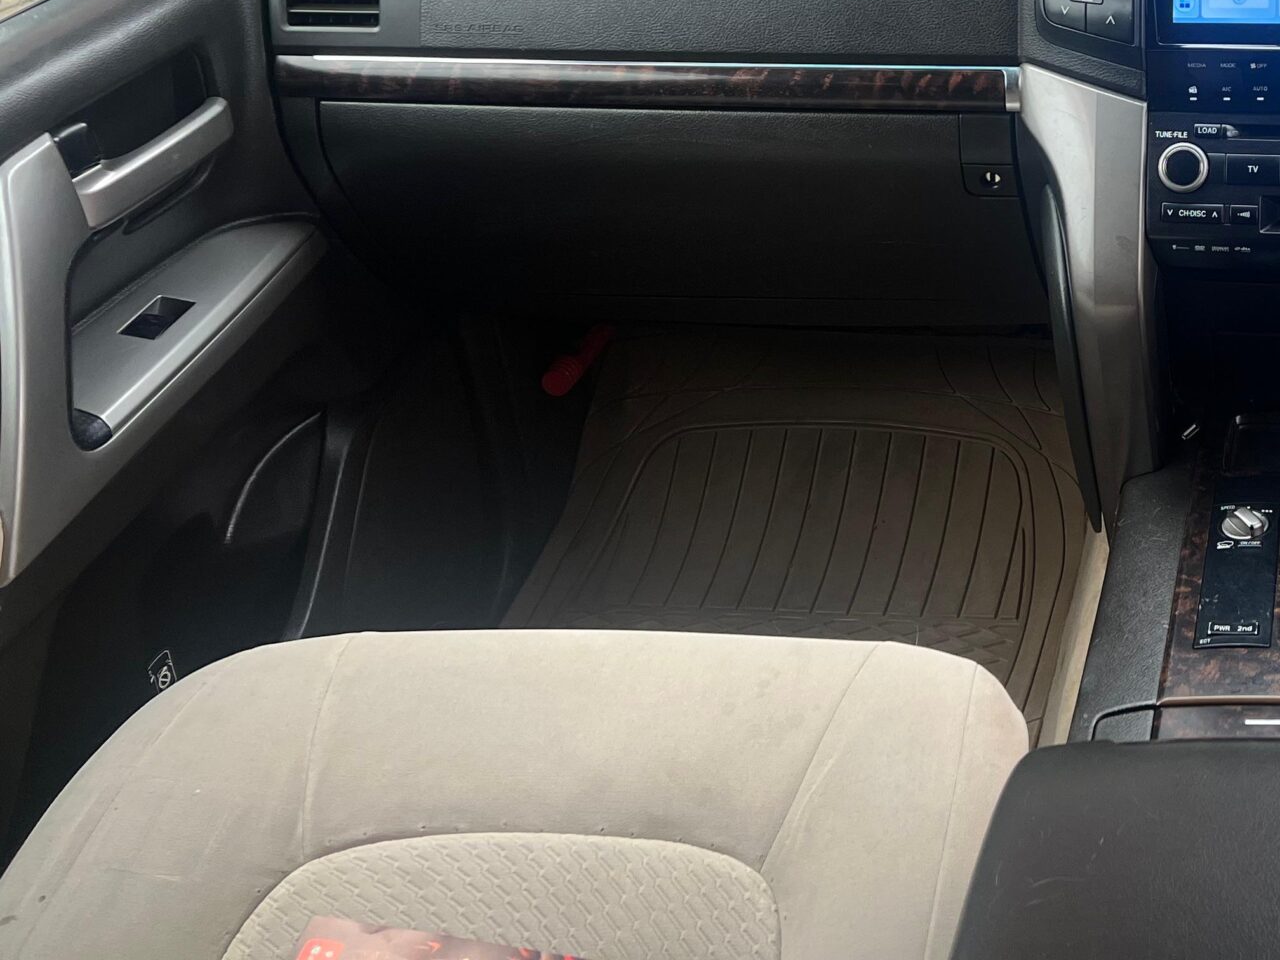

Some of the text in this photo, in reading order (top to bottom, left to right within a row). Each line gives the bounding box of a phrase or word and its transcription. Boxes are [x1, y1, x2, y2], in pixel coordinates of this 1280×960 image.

[1247, 165, 1259, 173] TV
[1213, 624, 1253, 632] PWR 2nd
